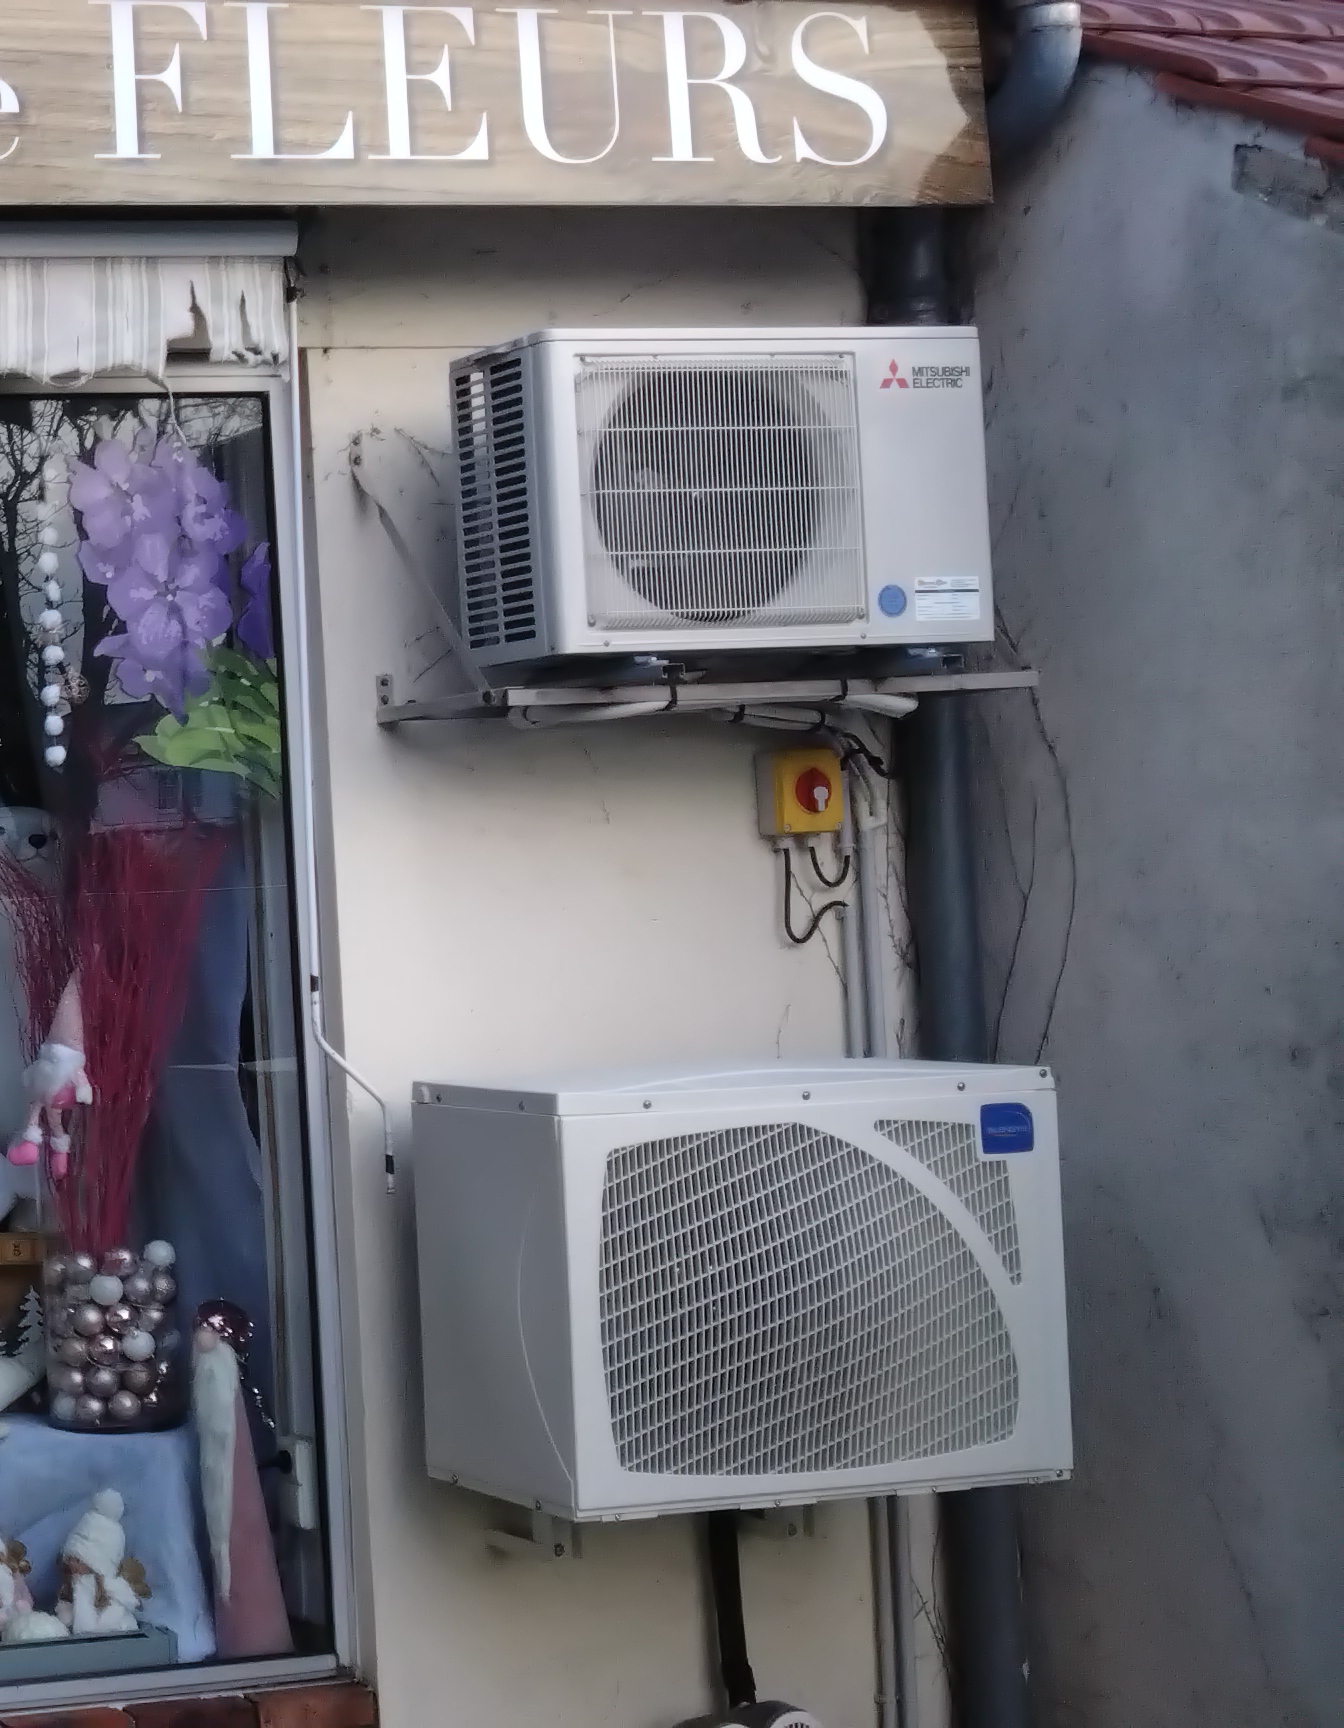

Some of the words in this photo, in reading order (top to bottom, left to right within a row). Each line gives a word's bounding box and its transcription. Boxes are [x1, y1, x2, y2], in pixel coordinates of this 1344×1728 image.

[87, 0, 889, 166] FLEURS
[912, 366, 971, 377] MITSUBISHI
[912, 378, 963, 389] ELECTRIC
